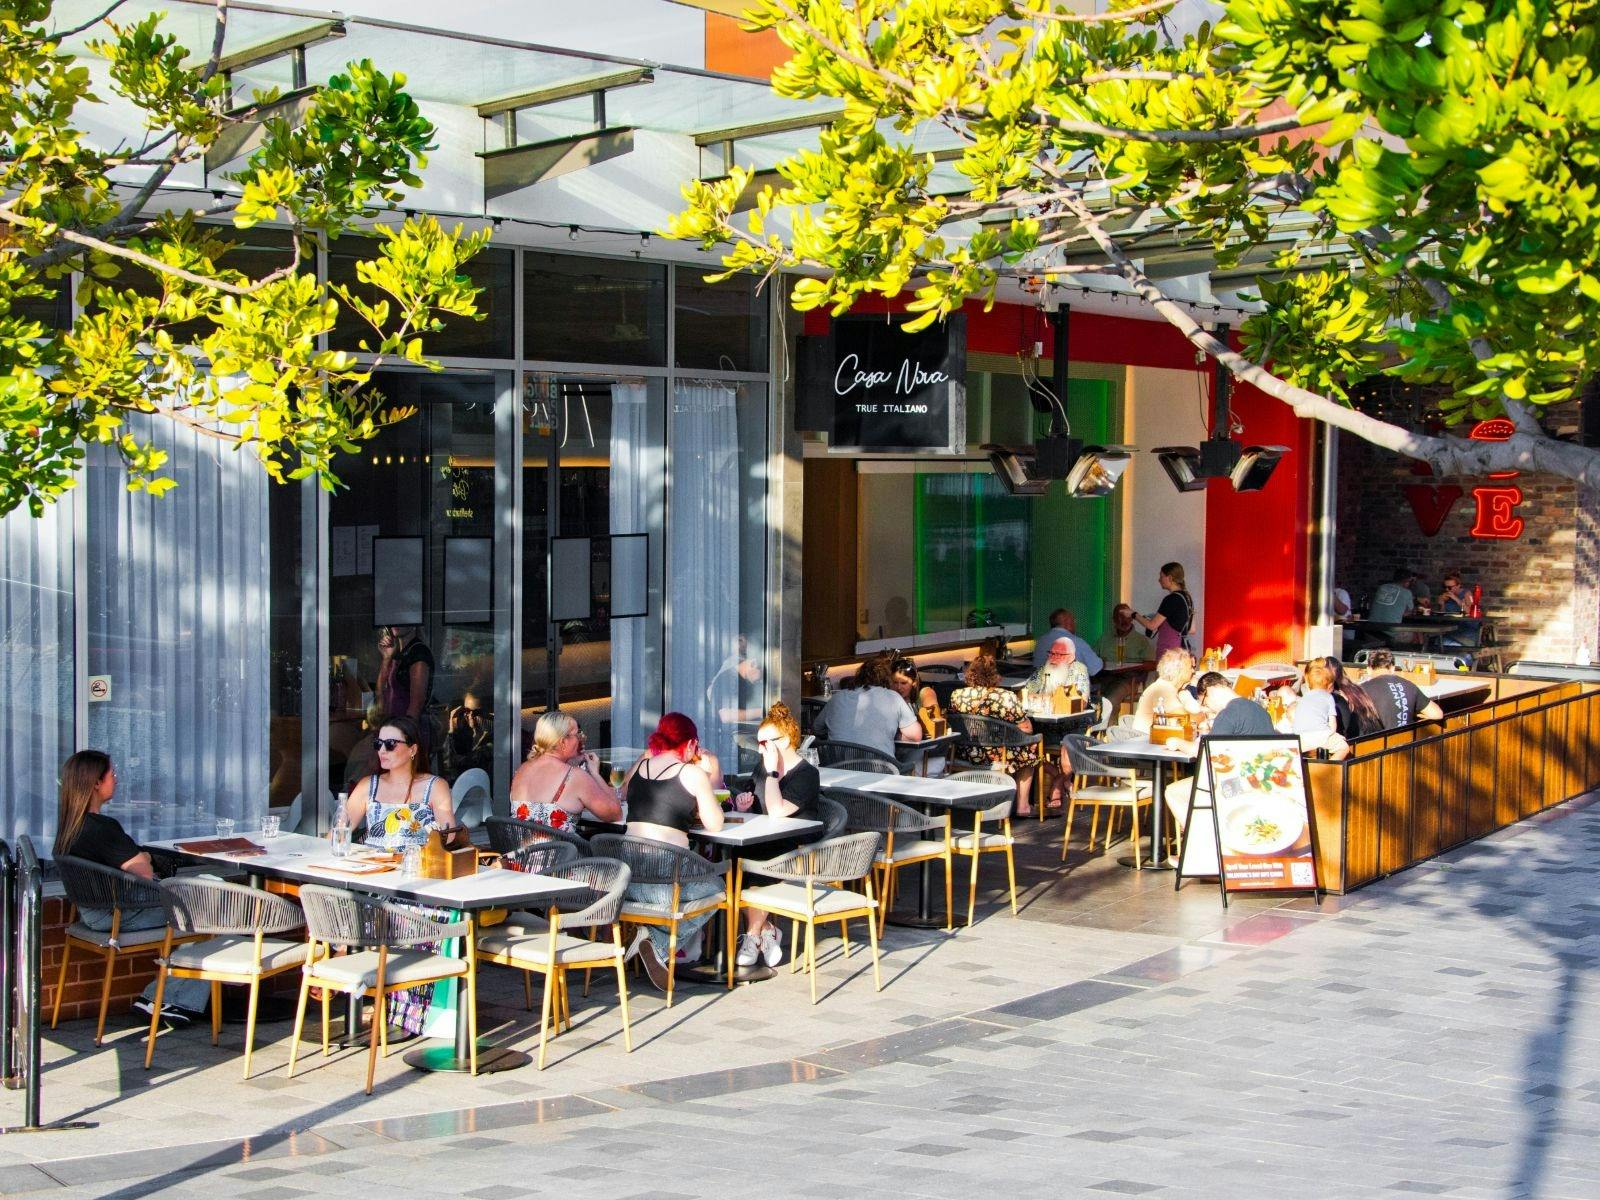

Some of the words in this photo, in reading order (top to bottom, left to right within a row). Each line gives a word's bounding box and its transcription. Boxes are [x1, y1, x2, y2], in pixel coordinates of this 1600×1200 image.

[834, 353, 892, 395] Casa
[895, 358, 949, 394] Nova
[855, 404, 878, 413] TRUE
[882, 404, 928, 413] ITALIANO
